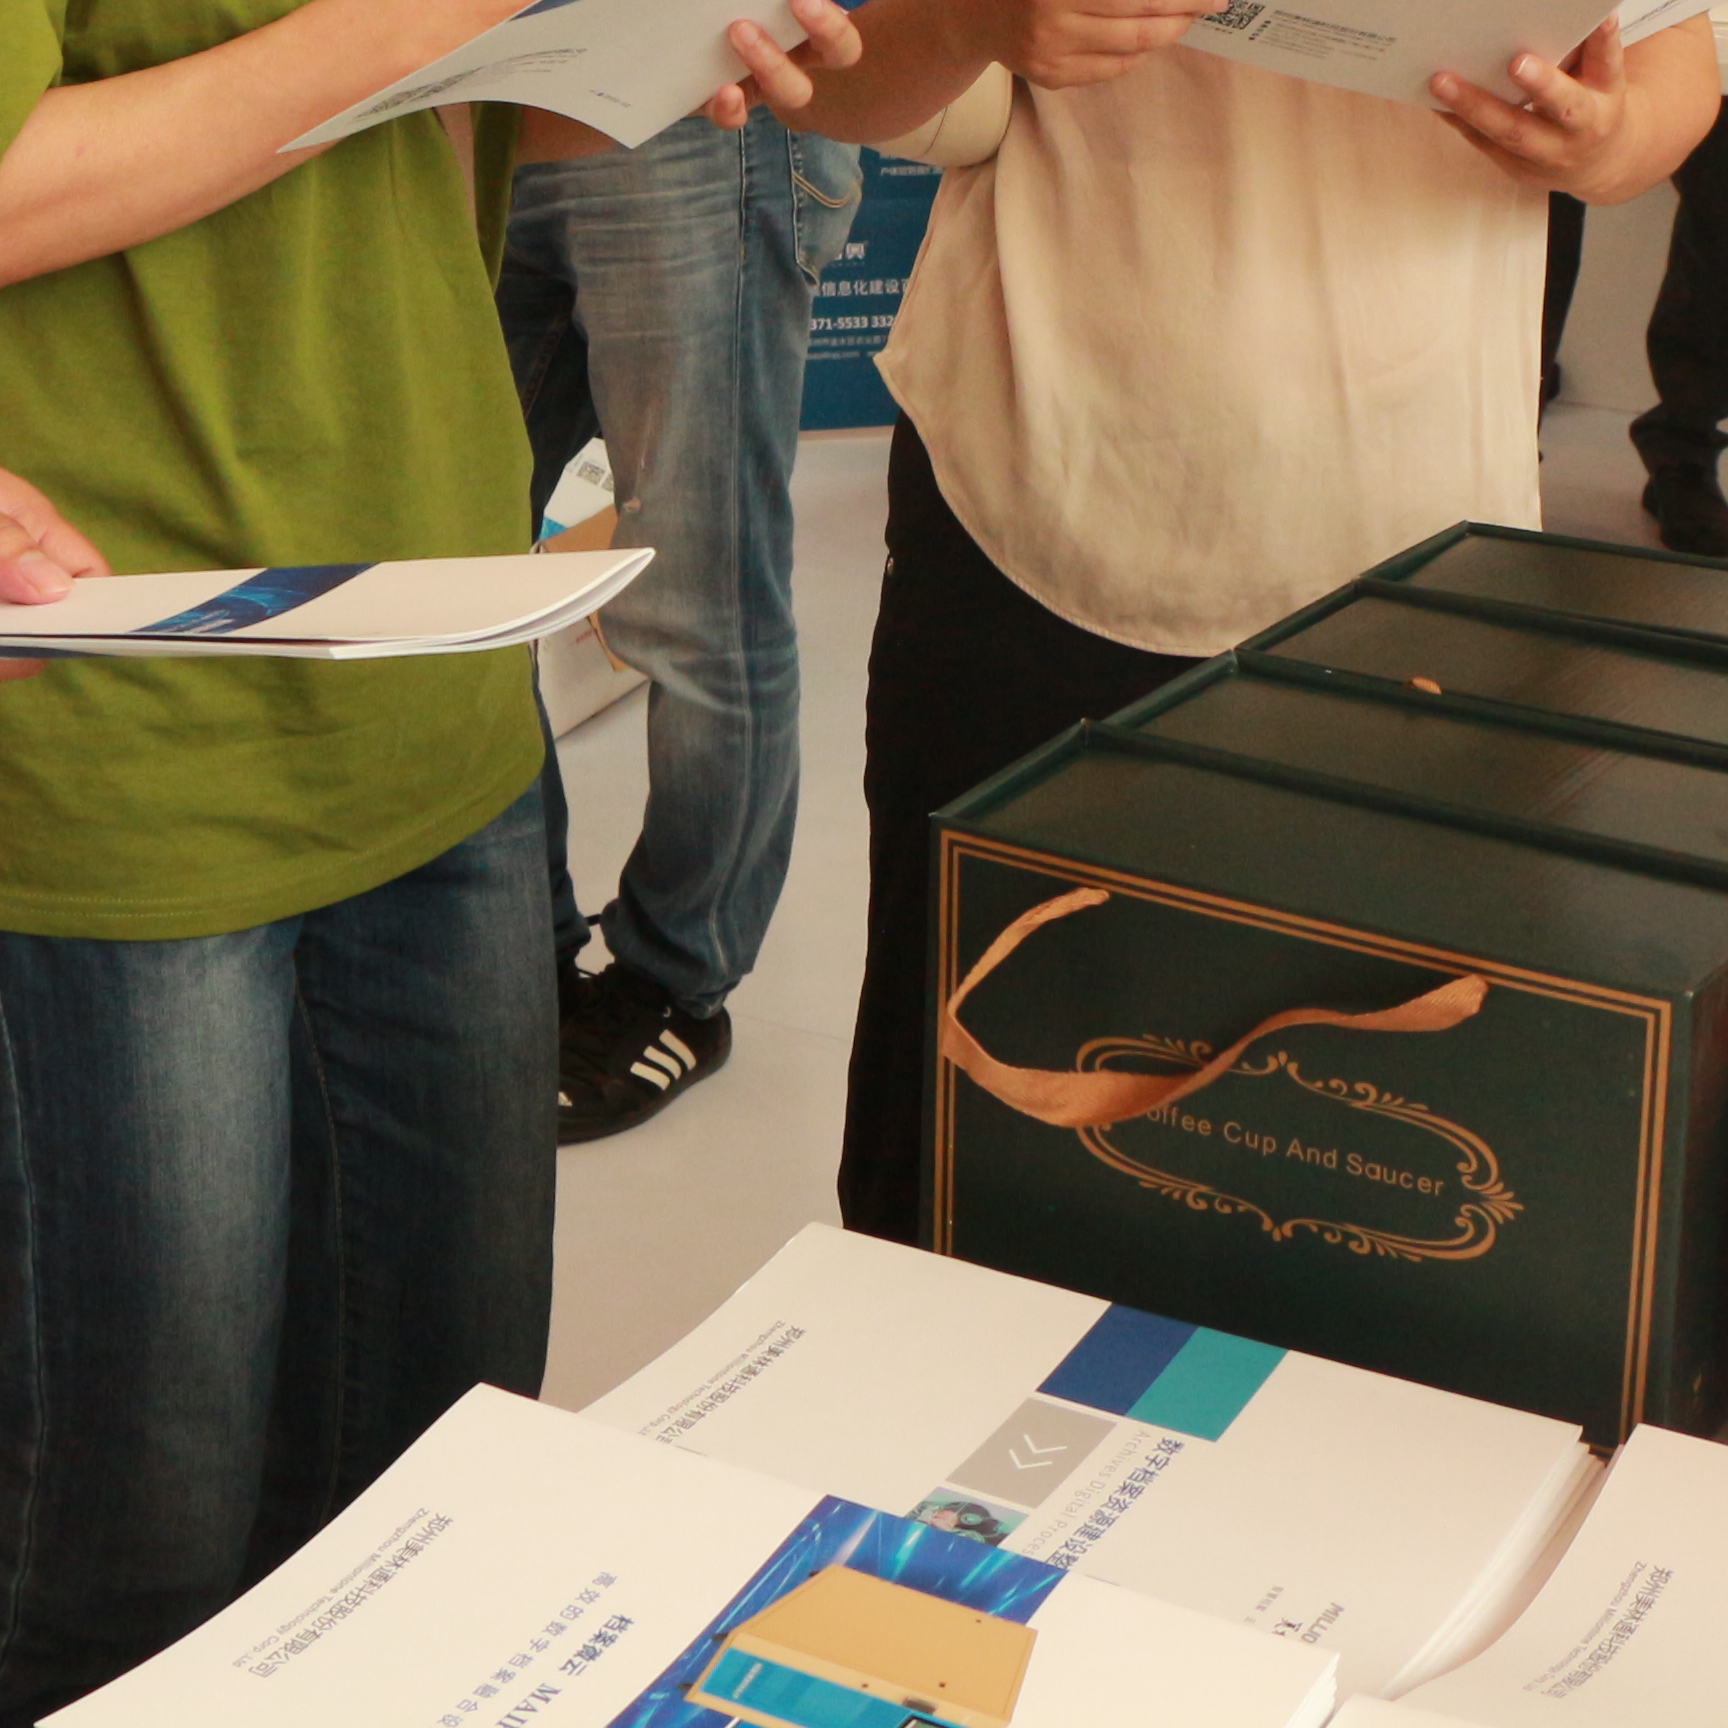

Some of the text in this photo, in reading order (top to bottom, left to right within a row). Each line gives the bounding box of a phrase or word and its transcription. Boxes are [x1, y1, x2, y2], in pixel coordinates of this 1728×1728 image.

[1145, 1103, 1447, 1197] offee Cup And Saucer
[246, 1511, 454, 1683] 郑州美林通科技股份有限公司
[275, 1593, 333, 1636] Technology
